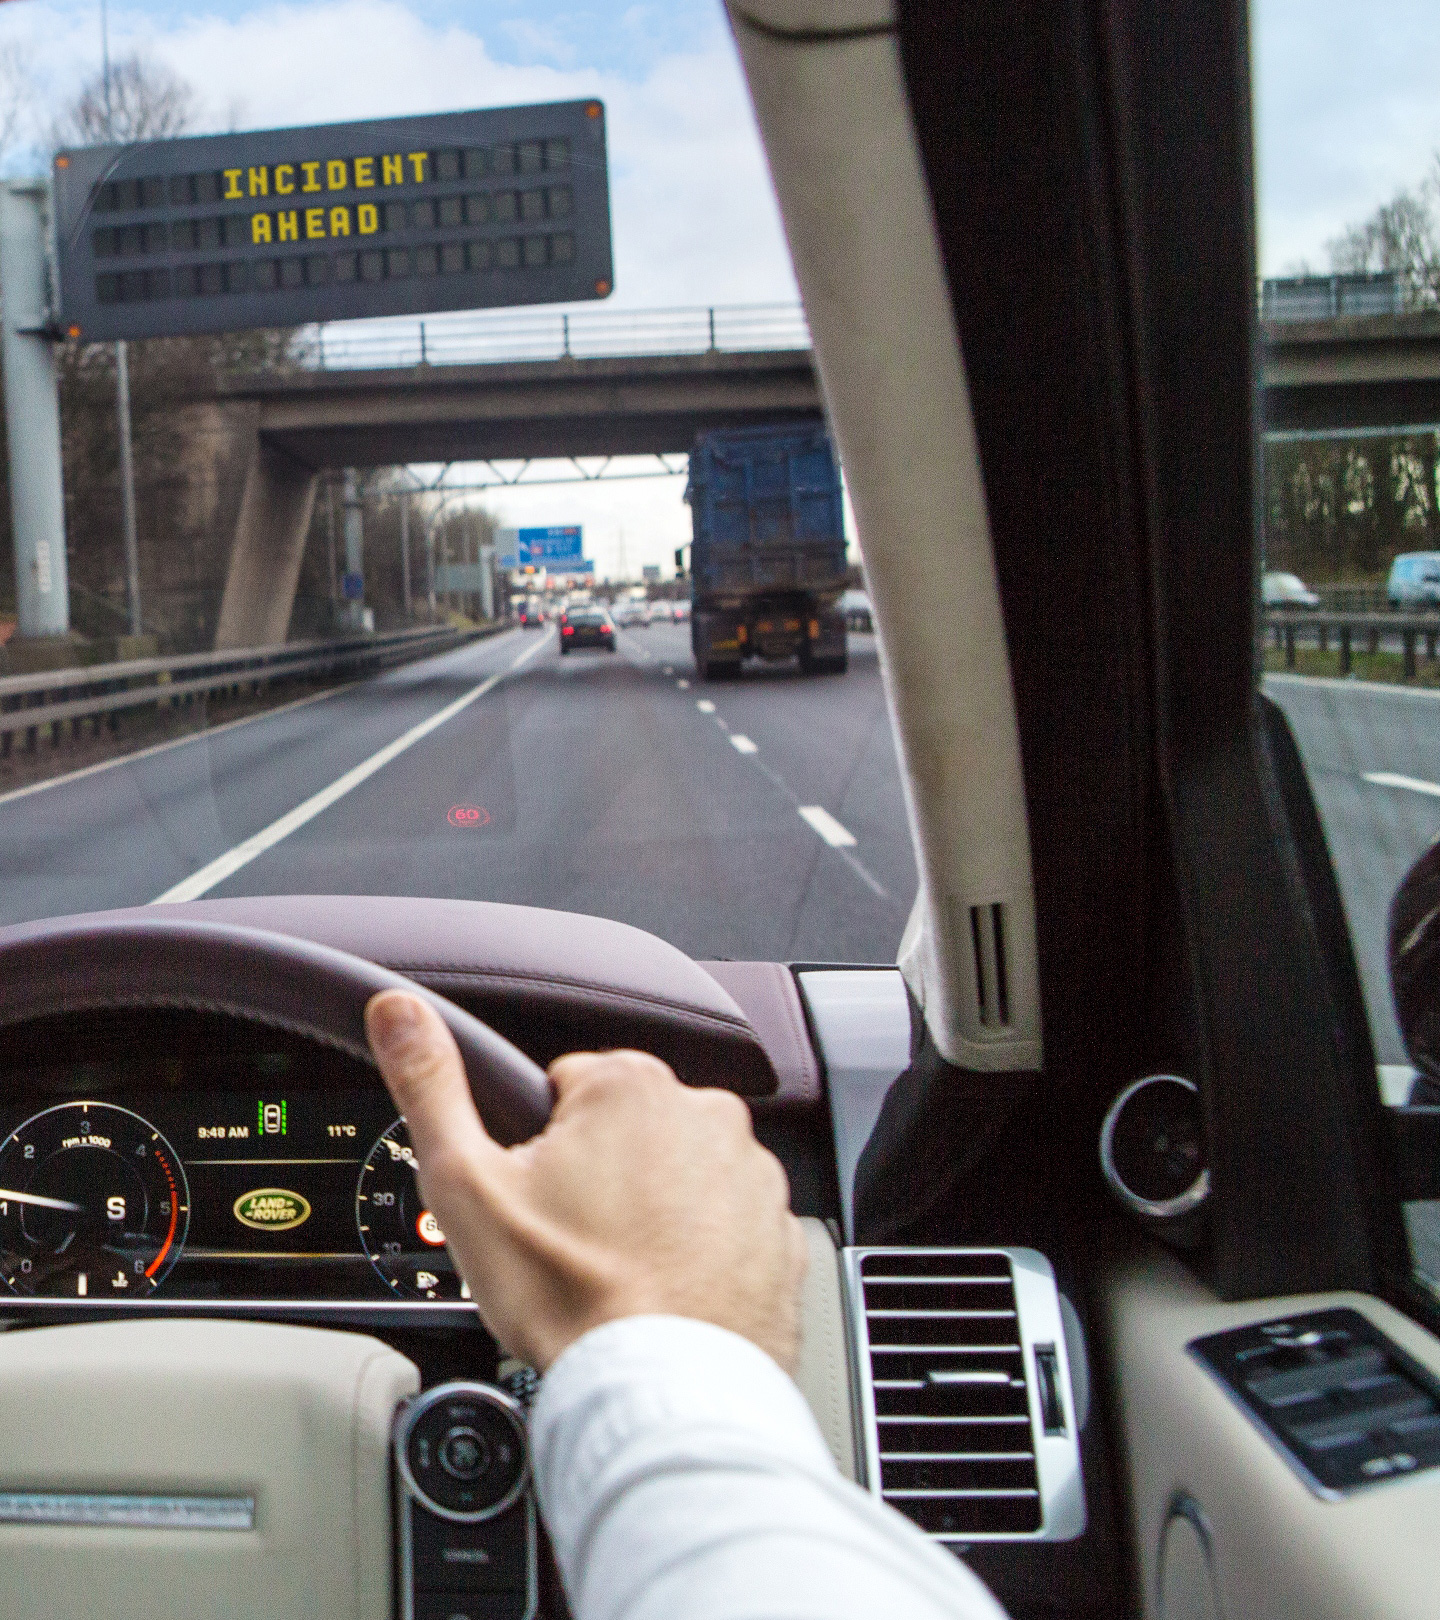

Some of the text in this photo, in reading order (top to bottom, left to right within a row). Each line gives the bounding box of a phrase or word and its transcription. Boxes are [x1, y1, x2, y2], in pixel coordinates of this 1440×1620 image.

[223, 152, 429, 200] INCIDENT
[251, 204, 378, 244] AHEAD
[456, 809, 479, 819] 60
[80, 1121, 91, 1134] 3
[228, 1126, 249, 1138] AM
[88, 1135, 112, 1148] 1000
[24, 1145, 35, 1159] 2
[135, 1145, 147, 1158] 4
[373, 1192, 395, 1206] 30
[0, 1201, 8, 1216] 1
[106, 1197, 126, 1220] S
[160, 1201, 171, 1214] 5
[21, 1259, 32, 1273] 0
[134, 1260, 145, 1274] 6
